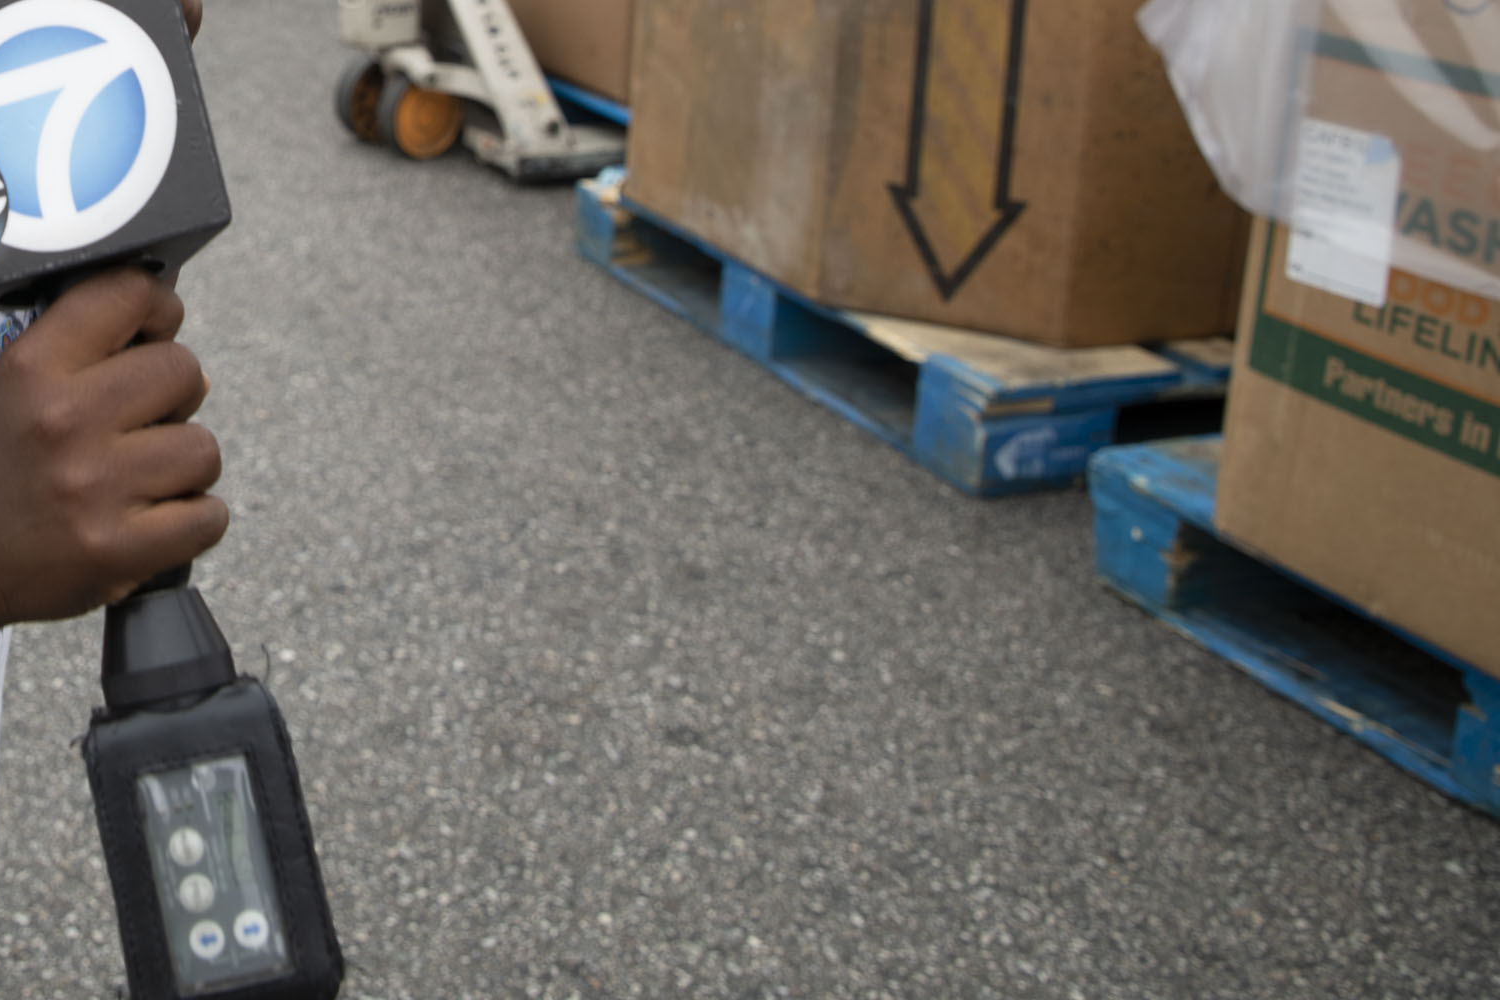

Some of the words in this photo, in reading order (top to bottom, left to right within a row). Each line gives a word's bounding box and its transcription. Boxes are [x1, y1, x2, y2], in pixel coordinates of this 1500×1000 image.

[1395, 188, 1500, 264] AS
[1322, 354, 1456, 437] Partners
[1459, 410, 1493, 454] in
